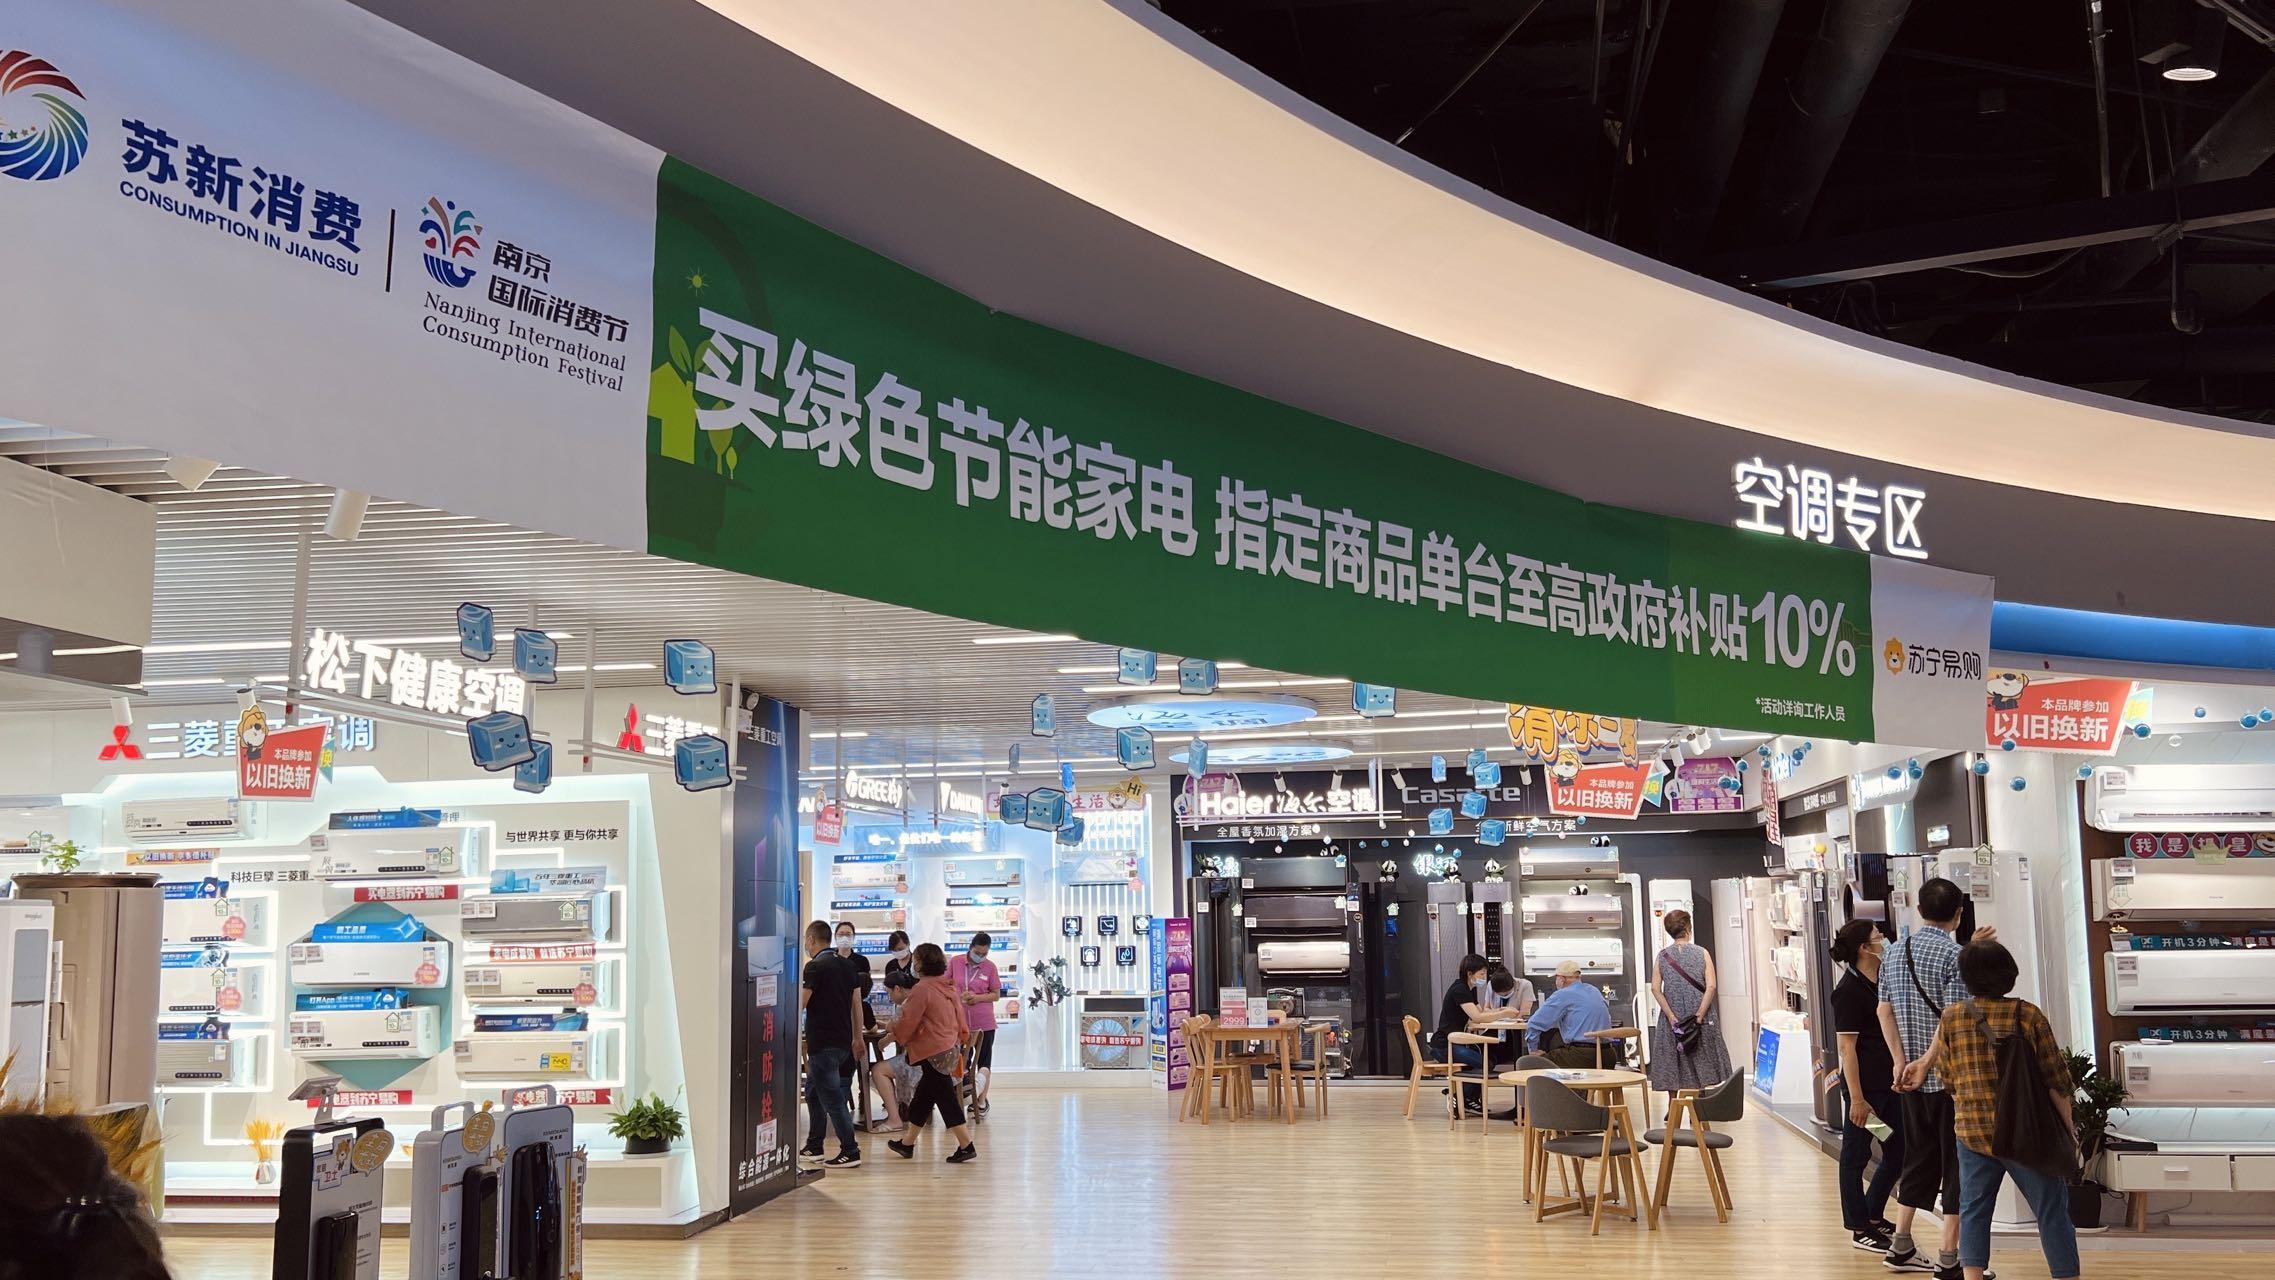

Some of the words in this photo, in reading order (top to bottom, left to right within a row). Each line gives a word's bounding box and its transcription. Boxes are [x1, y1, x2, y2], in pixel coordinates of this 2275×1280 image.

[120, 117, 364, 255] 苏新消费
[119, 180, 259, 243] CONSUMPTION
[263, 232, 281, 252] IN
[284, 239, 360, 277] JIANGSU
[491, 238, 551, 283] 南京
[487, 274, 630, 344] 国际消费节
[423, 291, 502, 335] Nanjing
[507, 318, 626, 372] International
[422, 316, 550, 370] Consumption
[556, 356, 624, 392] Festival
[694, 306, 1199, 559] 买绿色节能家电
[1215, 475, 1857, 678] 指定商品单台至高政府补贴10%
[1735, 457, 1929, 560] 空调专区
[304, 627, 527, 716] 松下健康空调
[1907, 644, 1982, 681] 苏宁易购
[2041, 698, 2110, 713] 本品牌参加
[1994, 713, 2110, 744] 以旧换新
[274, 748, 312, 763] 本品牌参加
[245, 763, 312, 791] 以旧换新
[1127, 782, 1142, 796] Hi
[1589, 778, 1635, 790] 本品牌参加
[1200, 791, 1274, 817] Haier
[1557, 788, 1634, 810] 以旧换新
[505, 826, 561, 843] 与世界共享
[563, 827, 619, 842] 更与你共享
[2161, 937, 2220, 948] 开机3分钟
[1223, 1016, 1245, 1026] 2999
[2169, 1029, 2228, 1040] 开机3分钟
[761, 1010, 775, 1123] 消防栓
[738, 1143, 790, 1182] 综合能源一体化
